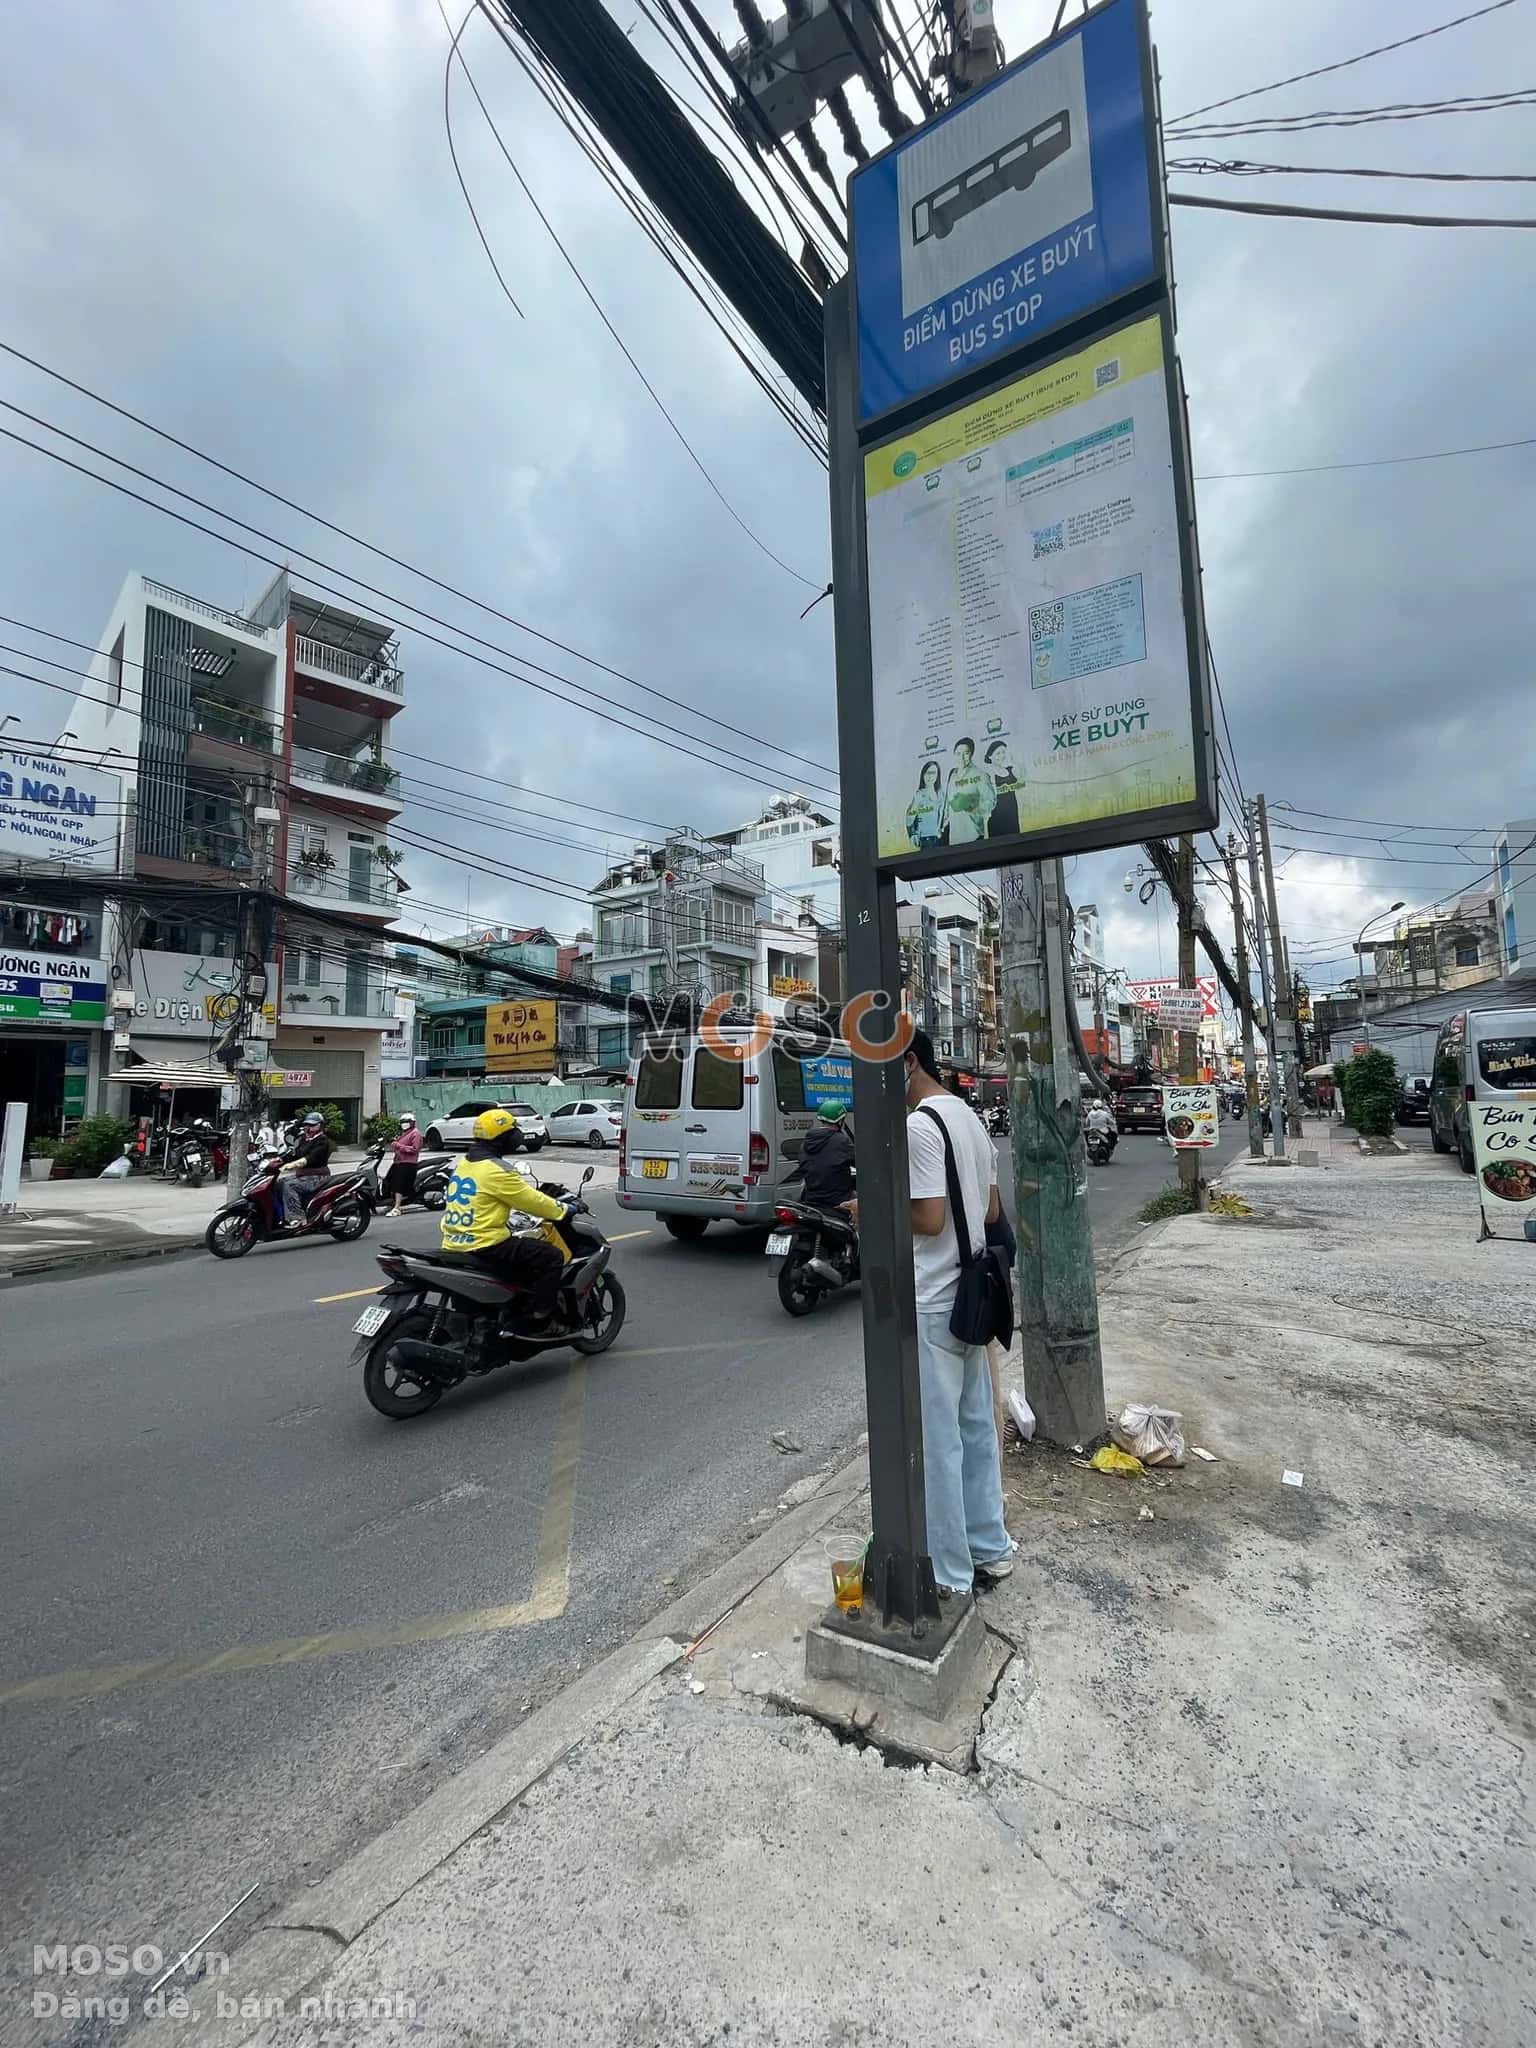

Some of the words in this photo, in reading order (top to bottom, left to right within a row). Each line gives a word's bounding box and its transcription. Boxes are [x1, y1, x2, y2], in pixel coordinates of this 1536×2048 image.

[904, 307, 945, 352] ĐIỂM
[951, 279, 1005, 325] DỪNG
[1011, 259, 1036, 293] XE
[1042, 223, 1097, 277] BUÝT
[950, 321, 986, 363] BUS
[993, 294, 1042, 340] STOP
[1051, 713, 1077, 730] HÃY
[1081, 706, 1102, 721] SỬ
[1105, 698, 1145, 717] DỤNG
[1052, 731, 1081, 751] XE
[1088, 711, 1150, 742] BUÝT
[33, 760, 66, 777] NHÂN
[62, 819, 83, 831] GPP
[857, 909, 871, 926] 12
[46, 961, 91, 979] NGÂN
[155, 998, 203, 1025] Điện
[1478, 1106, 1524, 1126] Bún
